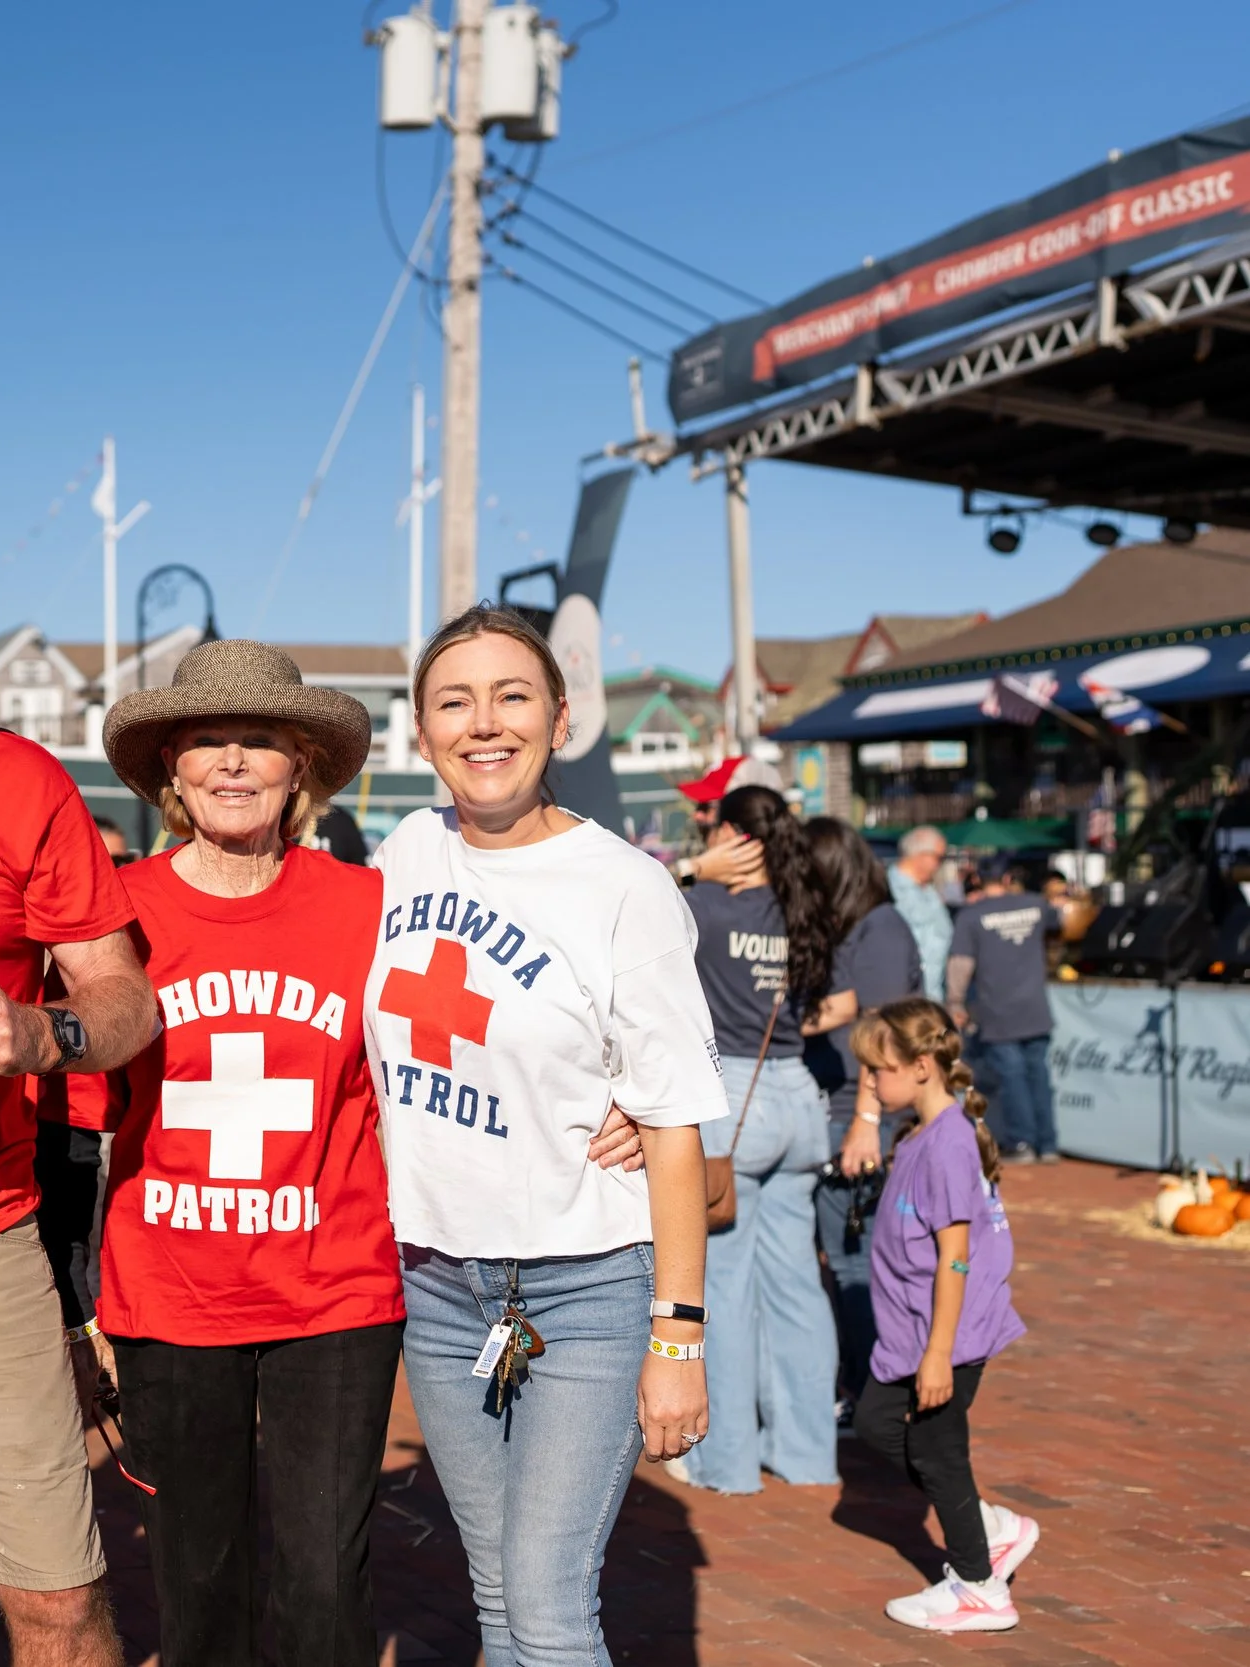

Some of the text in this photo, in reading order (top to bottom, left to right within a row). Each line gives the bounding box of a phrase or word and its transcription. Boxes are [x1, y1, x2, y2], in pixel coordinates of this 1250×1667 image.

[1130, 170, 1234, 227] CLASSIC
[385, 892, 552, 991] CHOWDA
[729, 931, 789, 962] VOLUN
[154, 969, 347, 1041] HOWDA
[143, 1178, 320, 1235] PATROL
